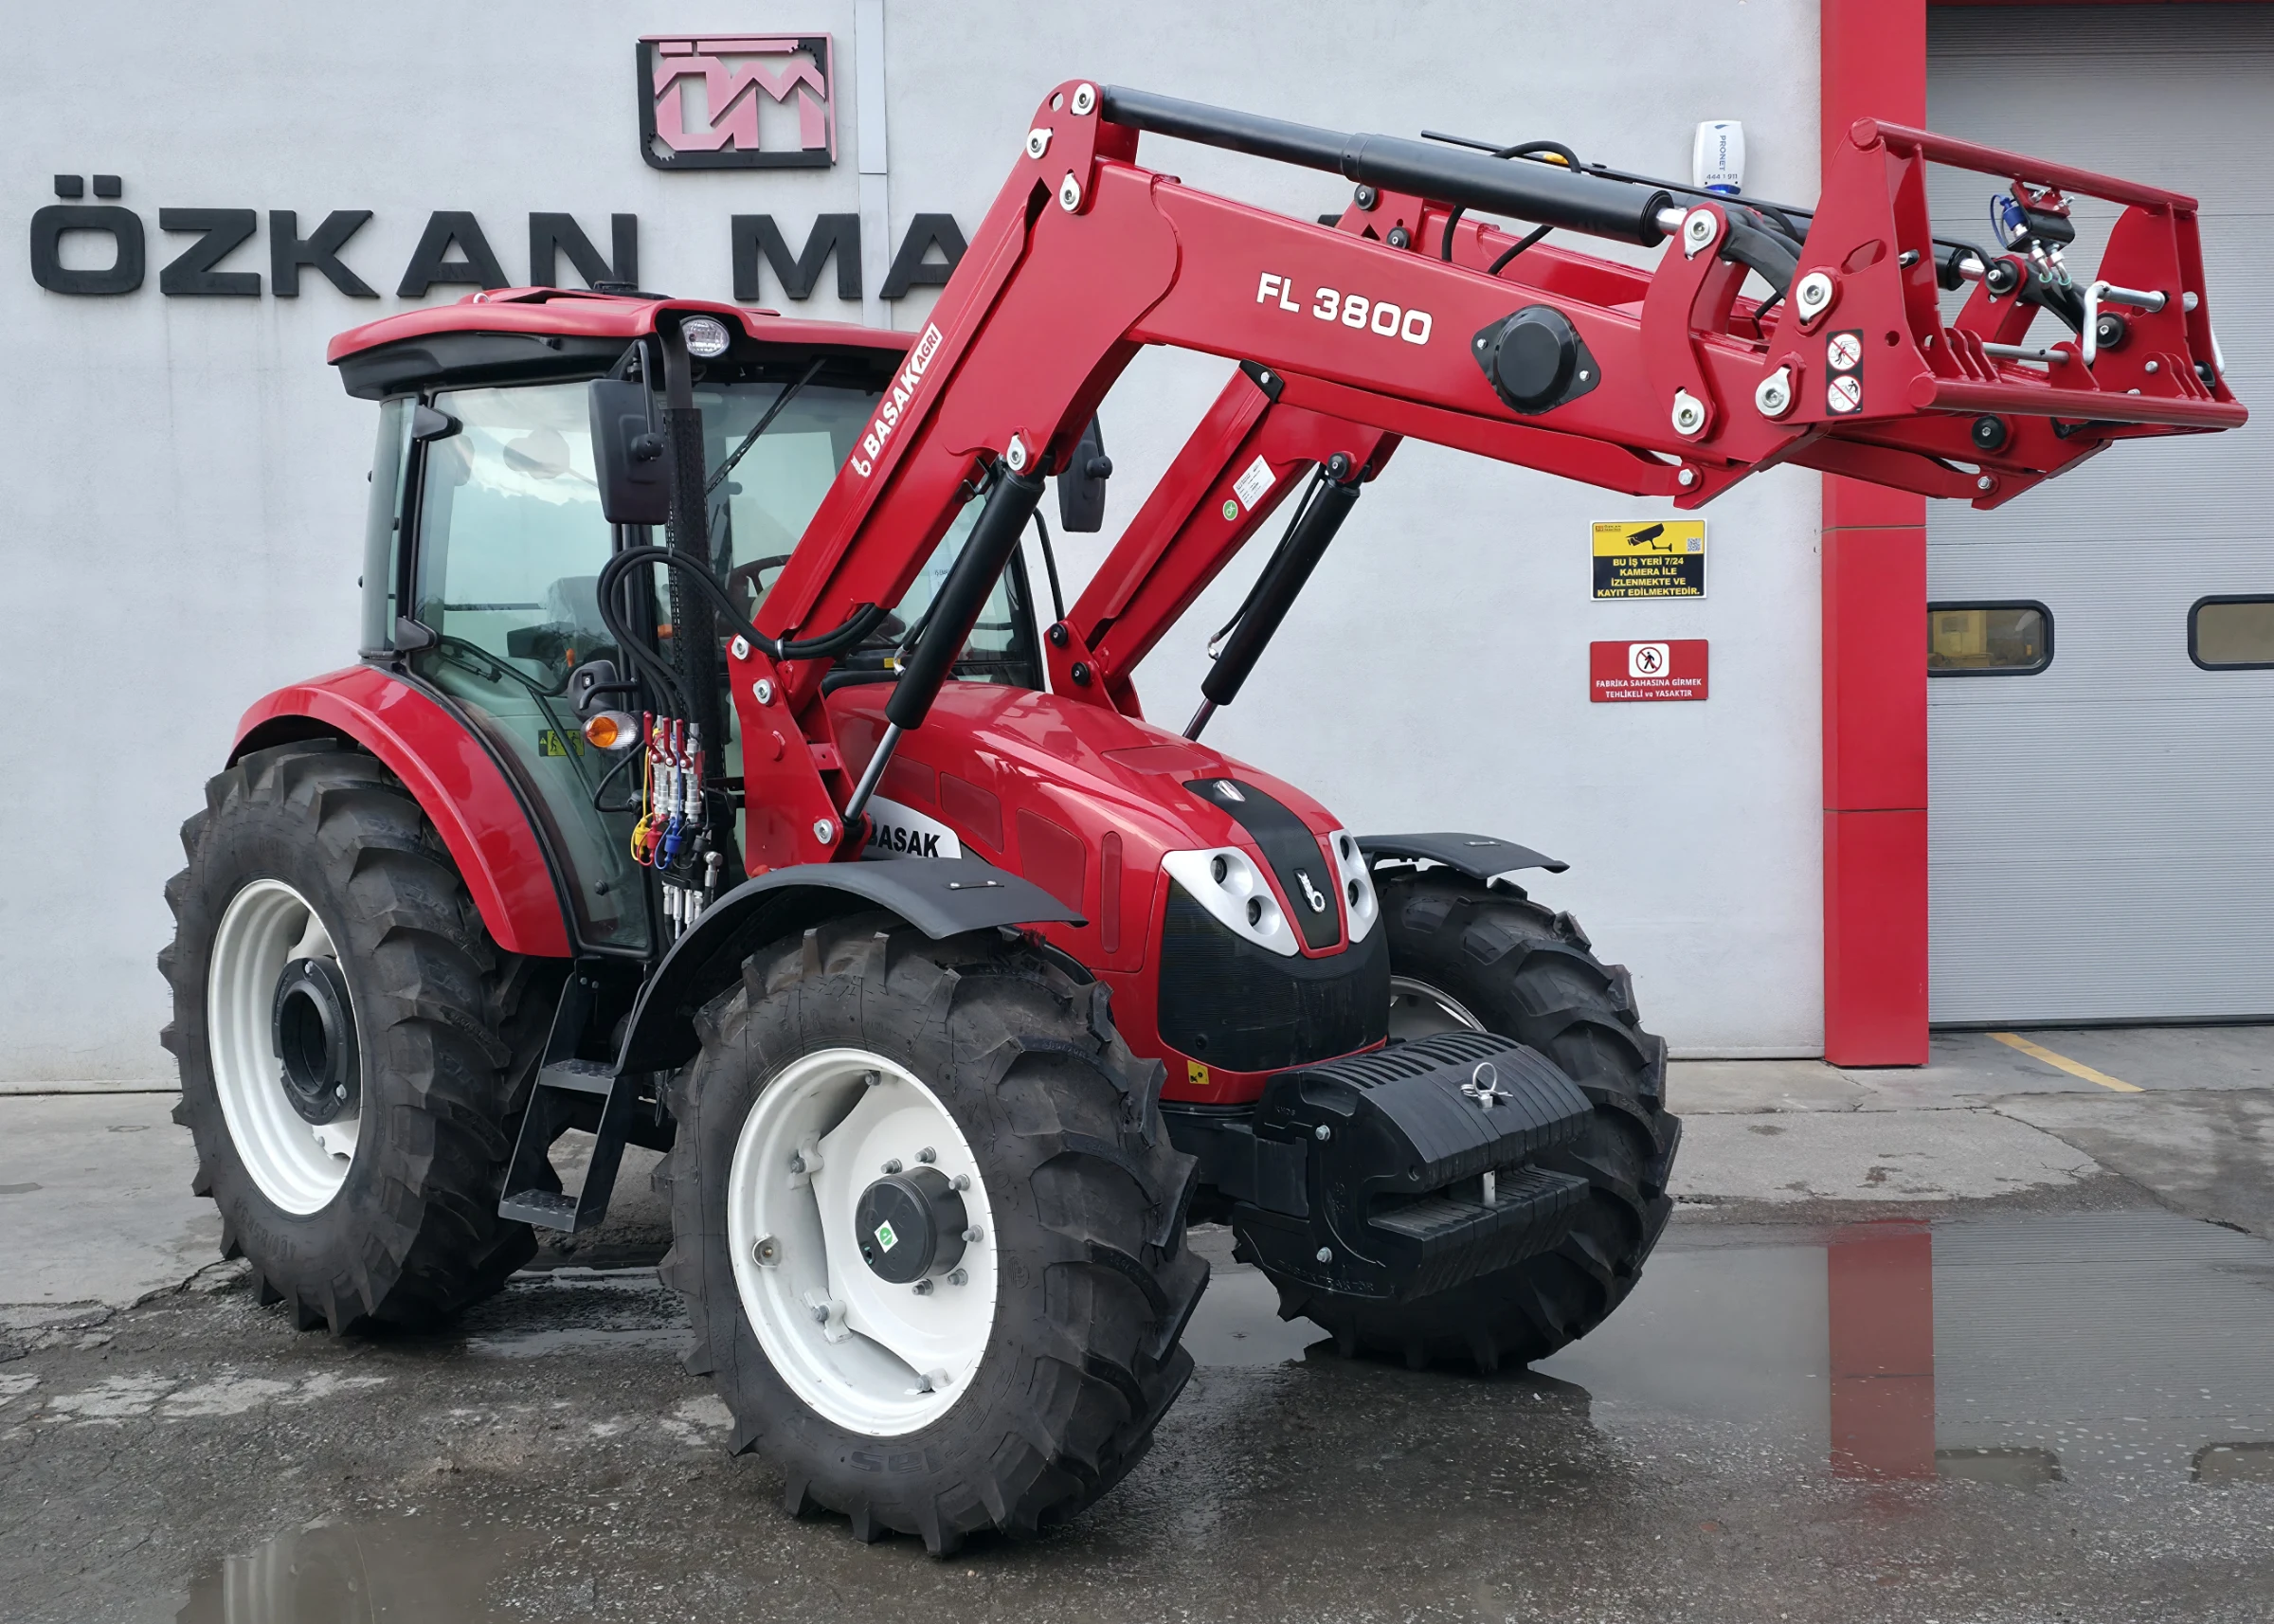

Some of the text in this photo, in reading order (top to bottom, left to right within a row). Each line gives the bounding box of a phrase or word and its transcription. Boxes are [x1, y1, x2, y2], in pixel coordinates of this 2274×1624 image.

[29, 174, 639, 298] ÖZKAN
[1255, 272, 1434, 346] FL 3800
[863, 362, 921, 460] BASAK
[916, 329, 939, 369] AGRI
[1613, 556, 1684, 568] BU İŞ YERİ 7/24
[1619, 567, 1677, 576] KAMERA İLE
[1611, 577, 1686, 586] İZLENMEKTE VE
[1597, 586, 1700, 597] KAYIT EDİLMEKTEDİR.
[1596, 677, 1702, 687] FABRİKA SAHASINA GİRMEK
[1605, 689, 1643, 698] TEHLİKELİ
[1655, 689, 1692, 697] YASAKTIR
